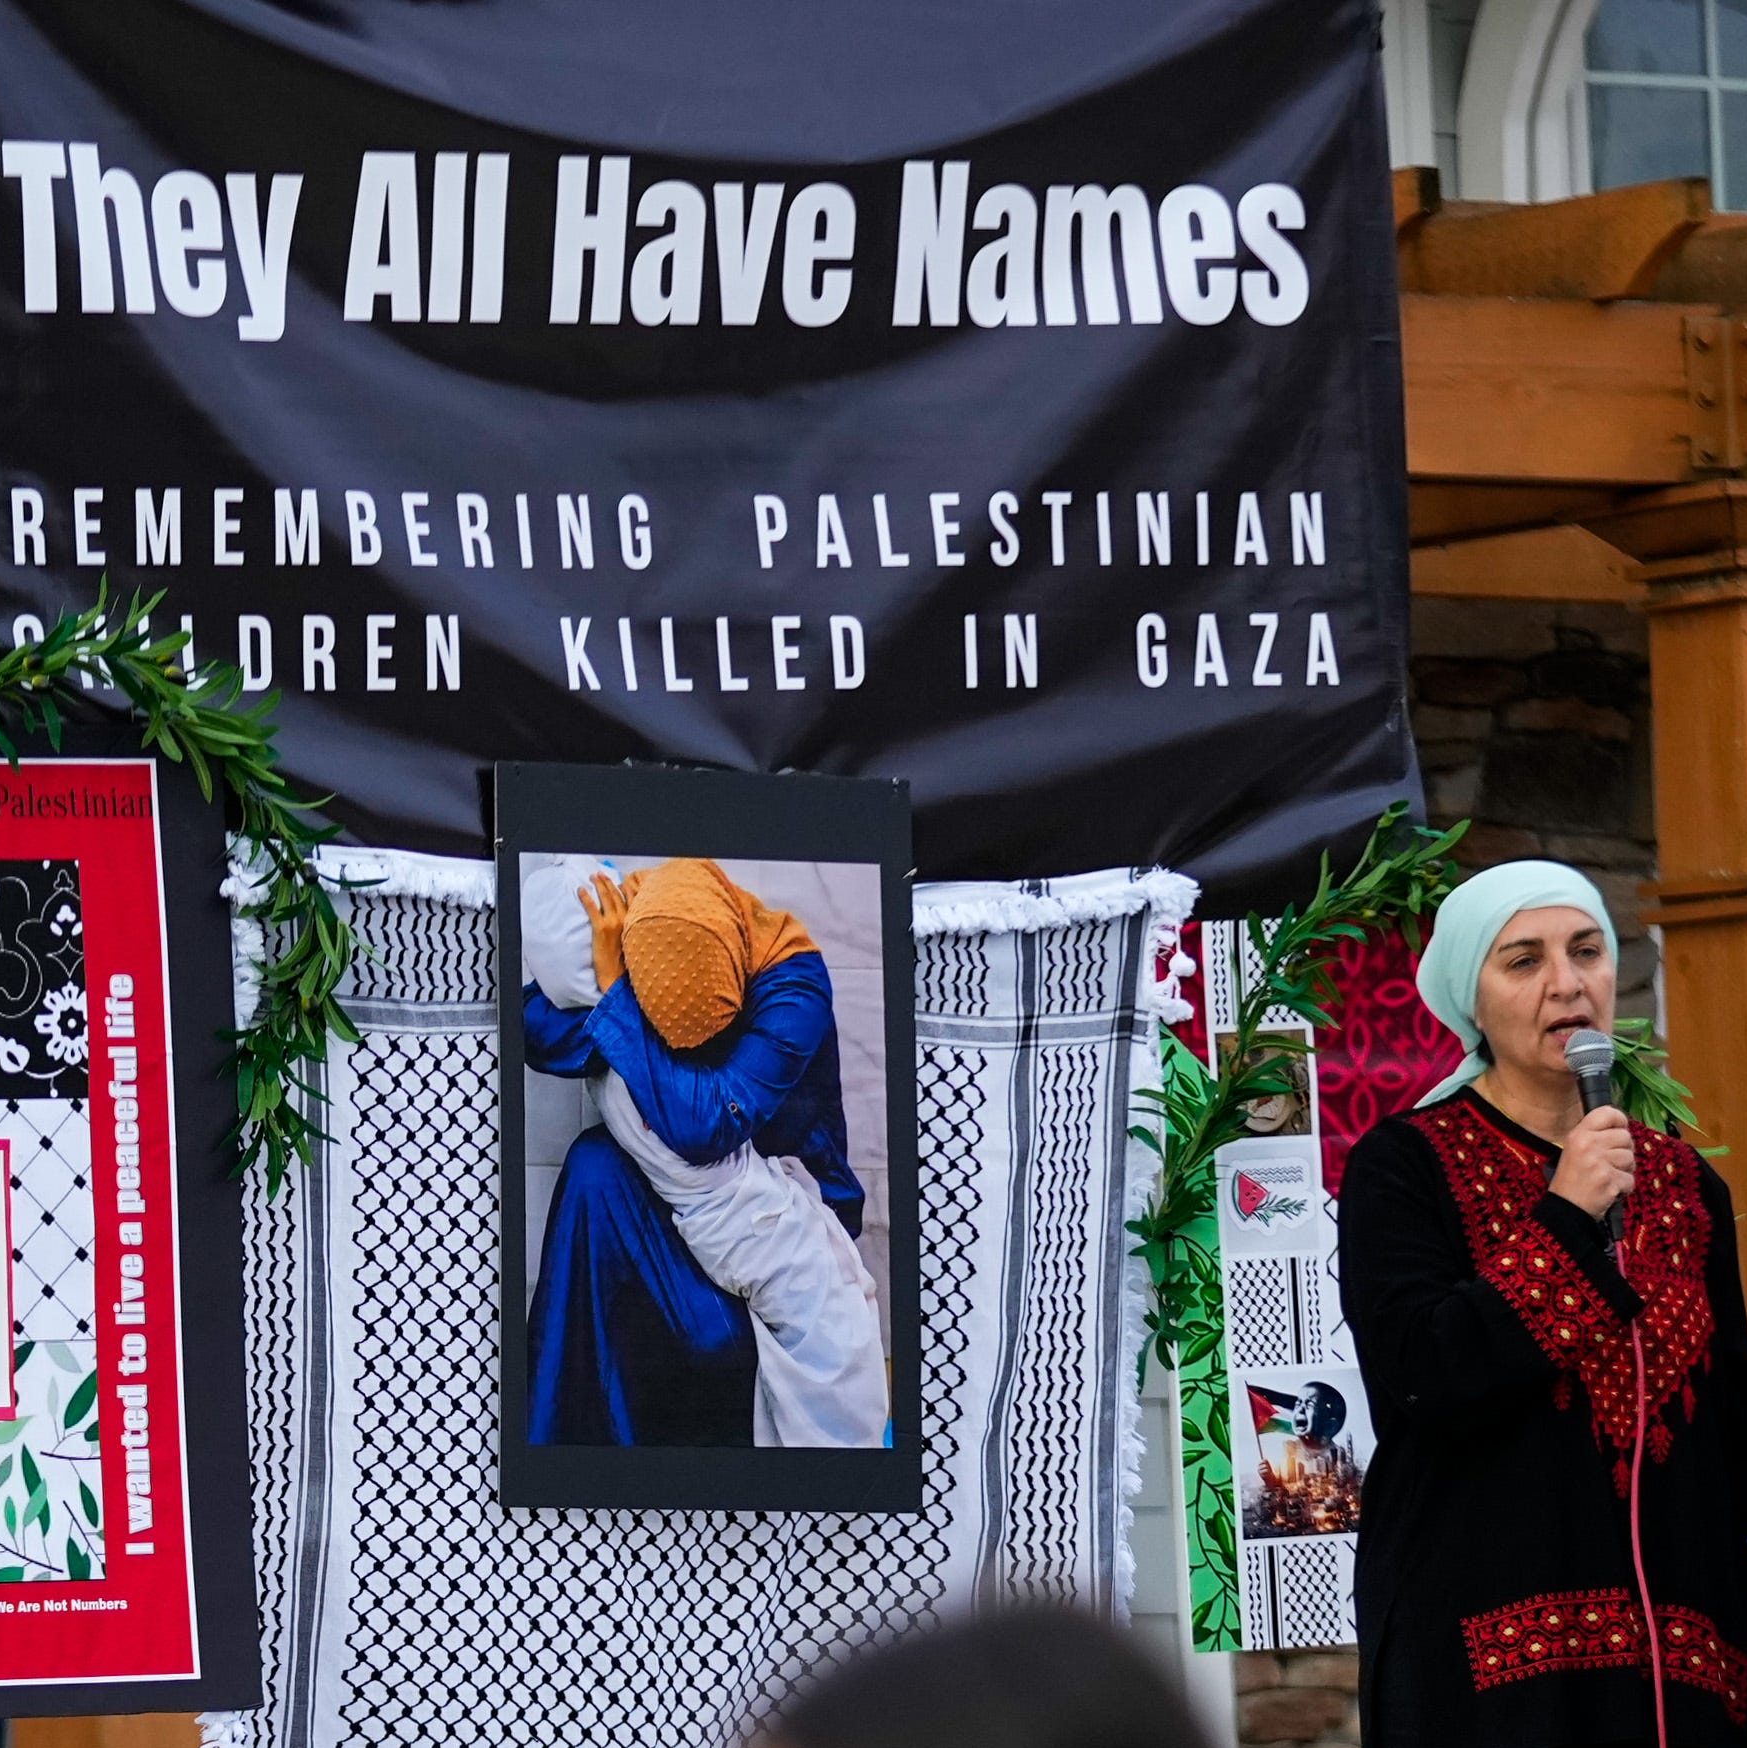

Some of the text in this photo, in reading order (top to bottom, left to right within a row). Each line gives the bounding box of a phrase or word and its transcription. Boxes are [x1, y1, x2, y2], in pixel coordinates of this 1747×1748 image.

[2, 140, 1311, 342] They All Have Names
[11, 486, 1328, 571] REMEMBERING PALESTINIAN
[561, 615, 866, 692] KILLED
[963, 613, 1038, 690] IN
[1136, 610, 1342, 689] GAZA
[105, 973, 136, 1038] life
[107, 1046, 146, 1214] peaceful
[119, 1222, 143, 1246] a
[113, 1253, 146, 1326] live
[118, 1333, 148, 1377] to
[116, 1384, 154, 1534] wanted
[17, 1600, 41, 1613] Are
[44, 1599, 67, 1612] Not
[70, 1598, 128, 1612] Numbers
